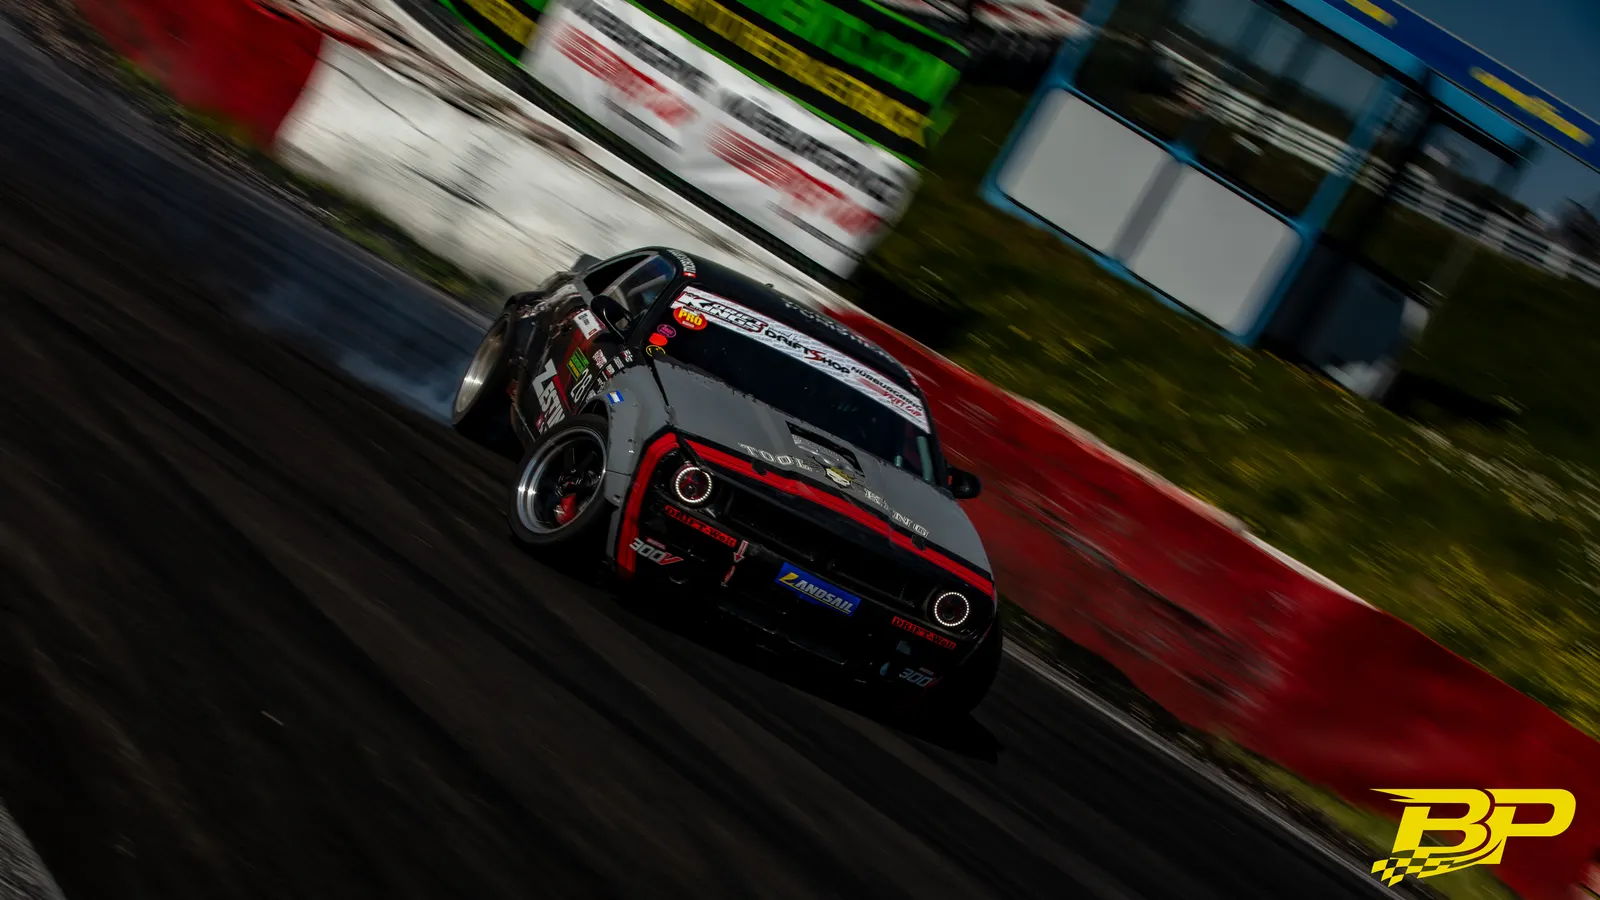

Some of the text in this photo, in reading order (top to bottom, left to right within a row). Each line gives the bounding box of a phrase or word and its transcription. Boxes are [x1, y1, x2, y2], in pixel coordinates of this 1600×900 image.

[678, 310, 703, 326] PRO
[738, 442, 813, 472] TOOL
[629, 537, 684, 566] 300V
[779, 572, 854, 615] LANDSAIL
